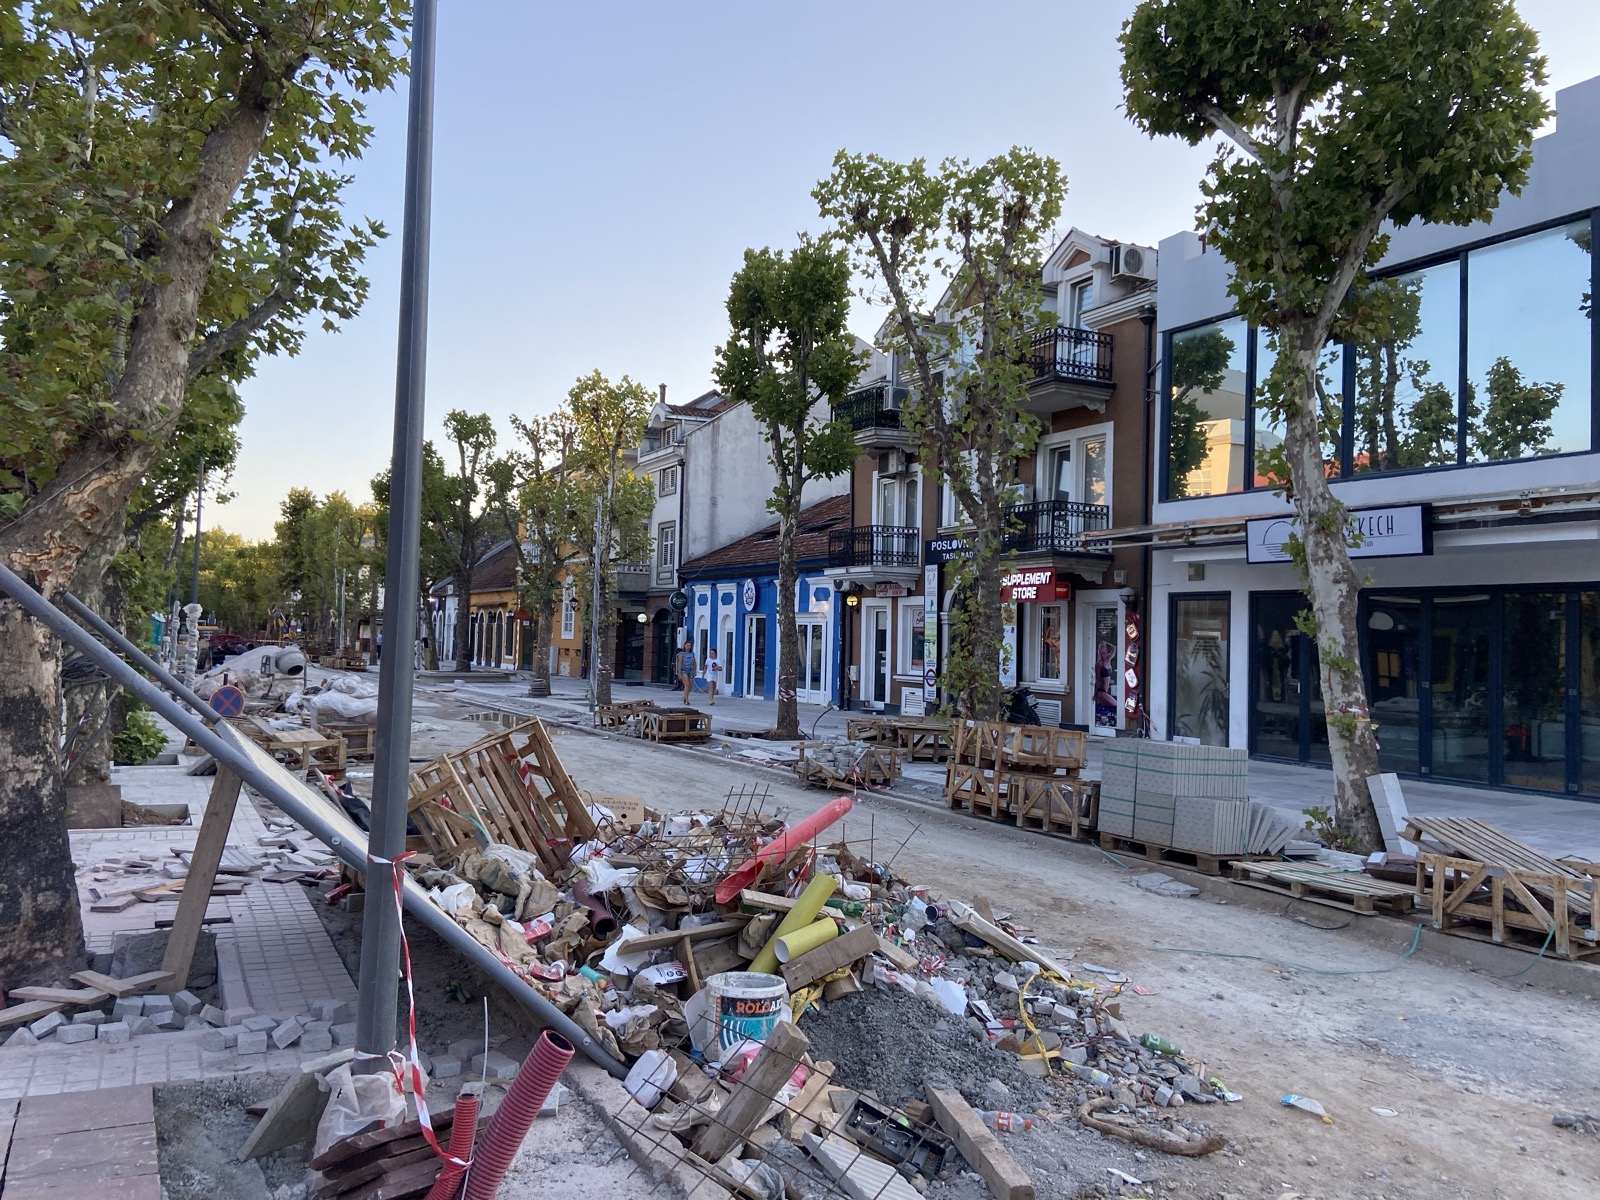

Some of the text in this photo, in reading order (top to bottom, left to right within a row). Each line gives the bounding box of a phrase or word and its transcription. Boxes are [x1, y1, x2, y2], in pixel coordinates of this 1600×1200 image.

[1347, 515, 1394, 537] AKECH
[931, 539, 970, 551] POSLOVN
[1002, 571, 1051, 586] SUPPLEMENT
[1012, 587, 1037, 599] STORE
